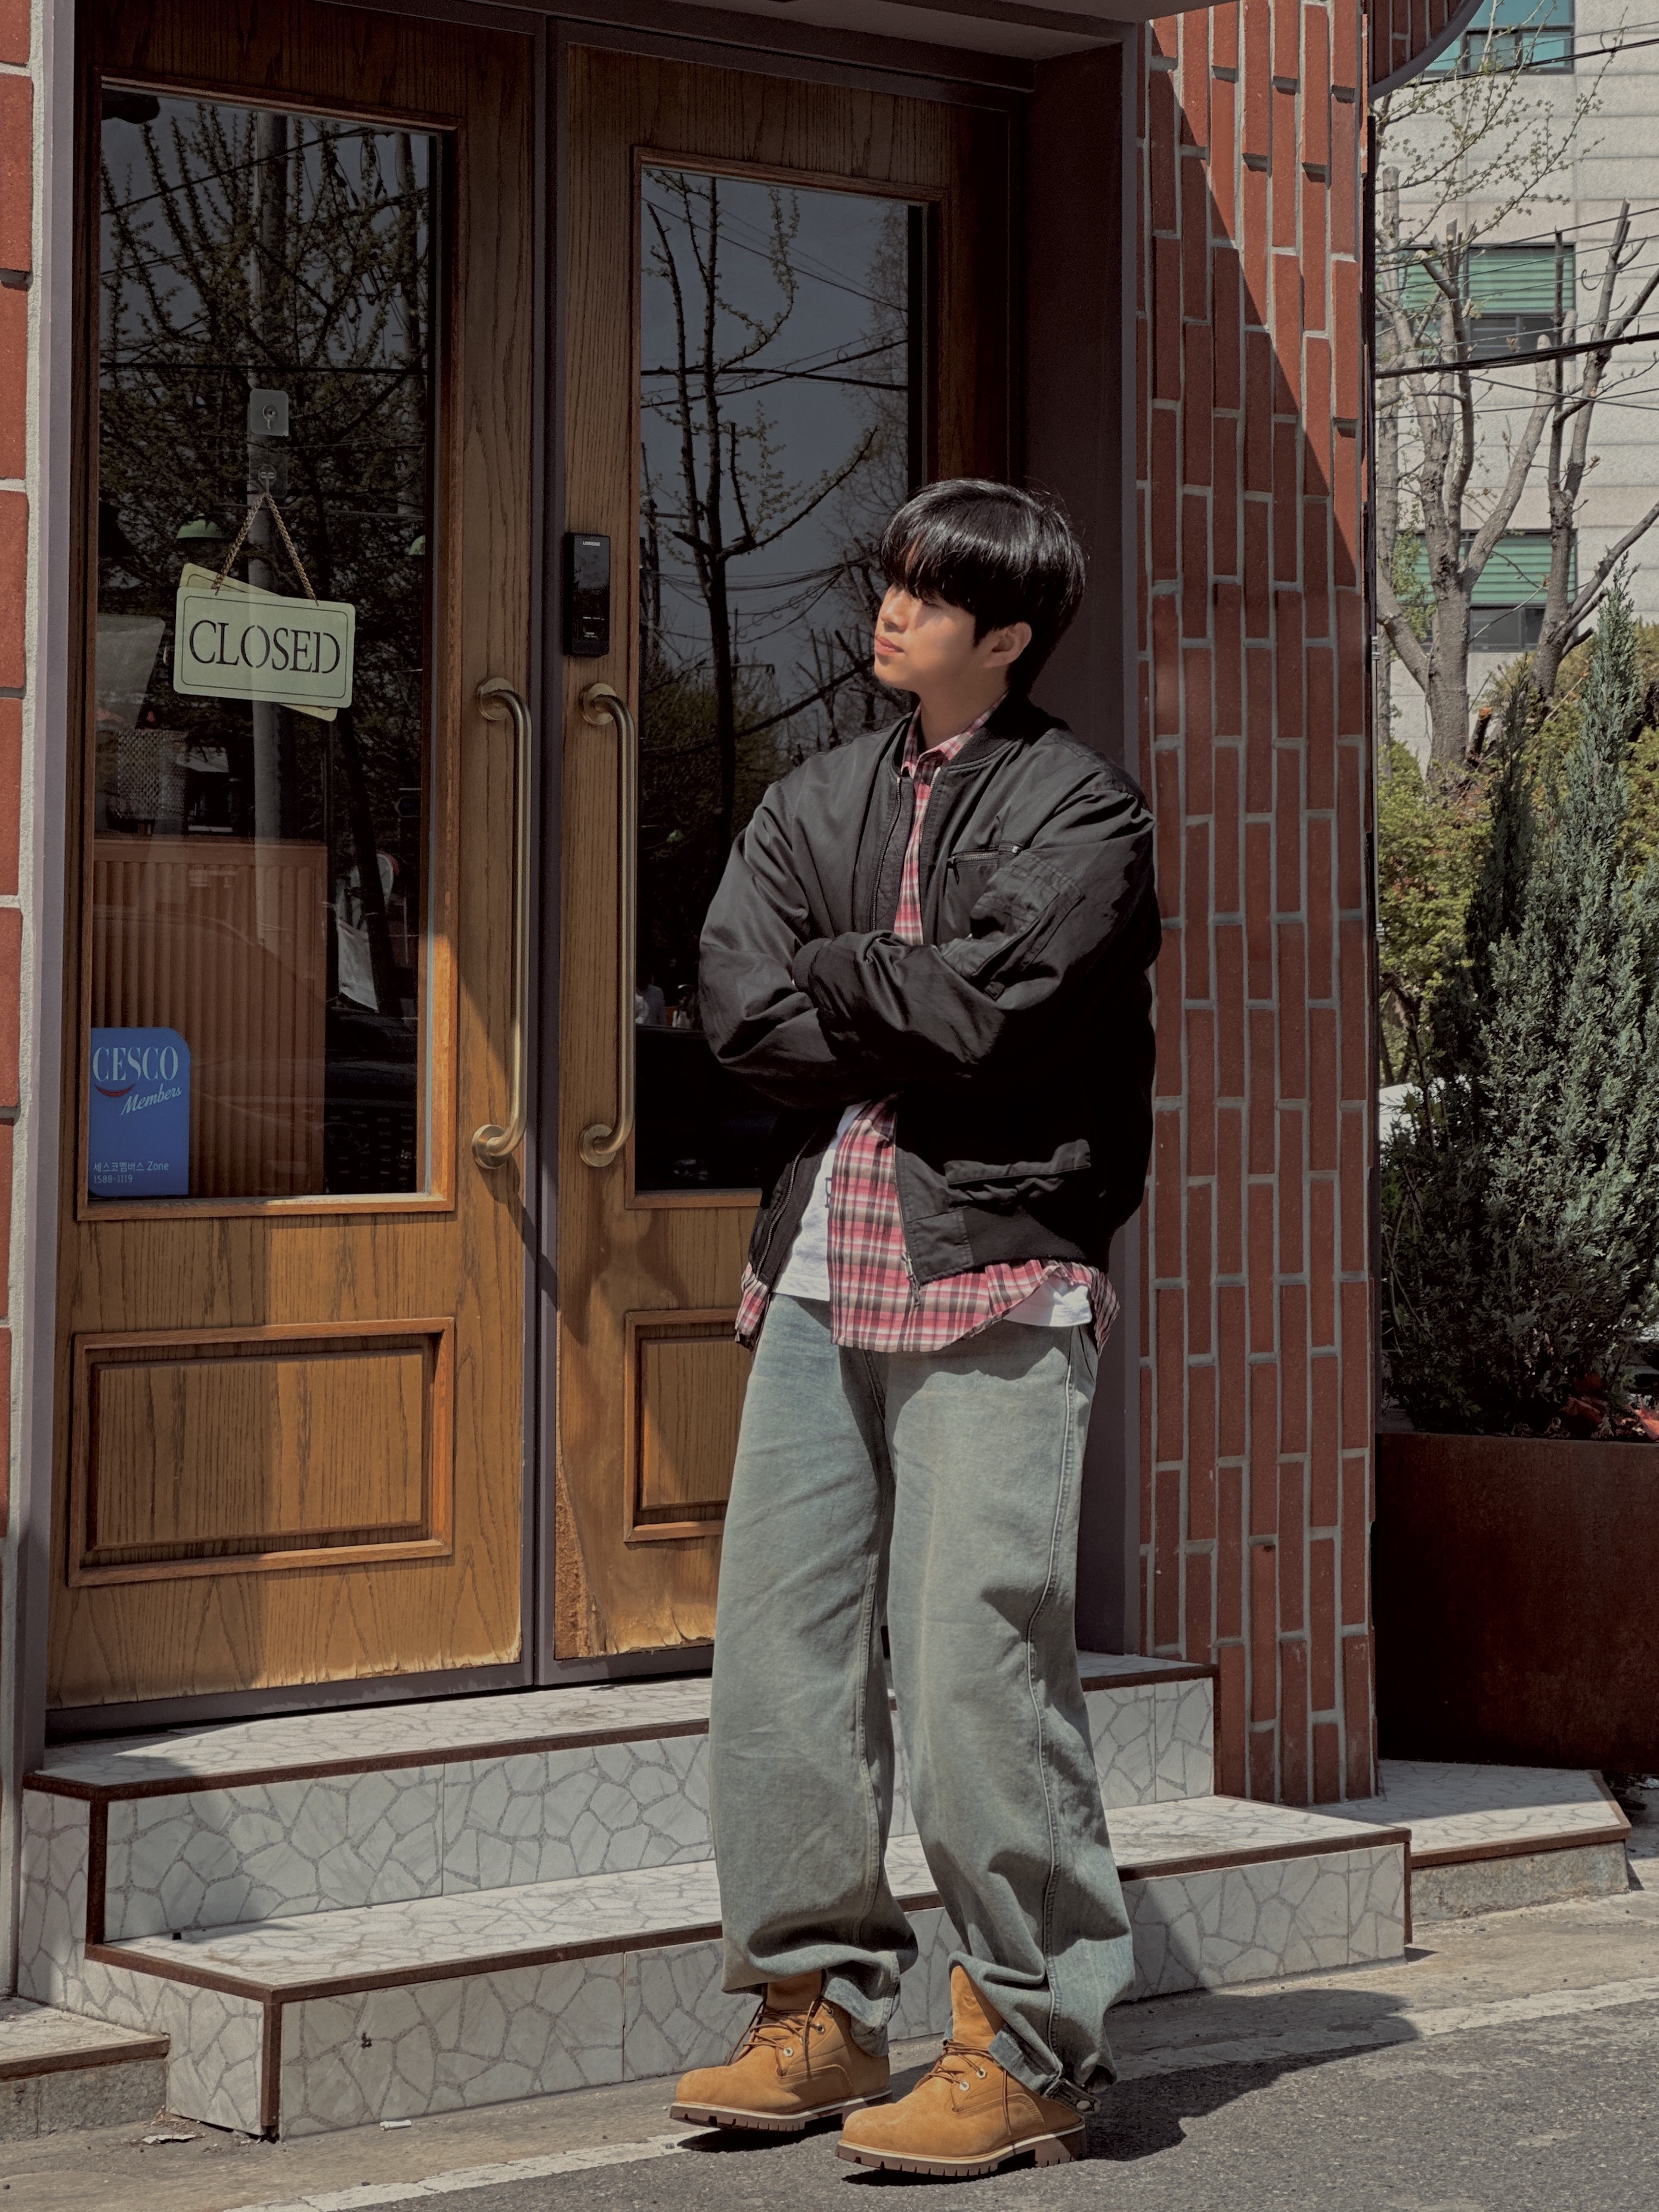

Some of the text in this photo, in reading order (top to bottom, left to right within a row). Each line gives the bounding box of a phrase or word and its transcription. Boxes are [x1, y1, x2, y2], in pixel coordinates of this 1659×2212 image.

[189, 620, 341, 673] CLOSED
[92, 1045, 178, 1081] CESCO
[120, 1082, 182, 1116] Members
[94, 1174, 133, 1183] 1588-1119
[147, 1161, 169, 1171] Zone
